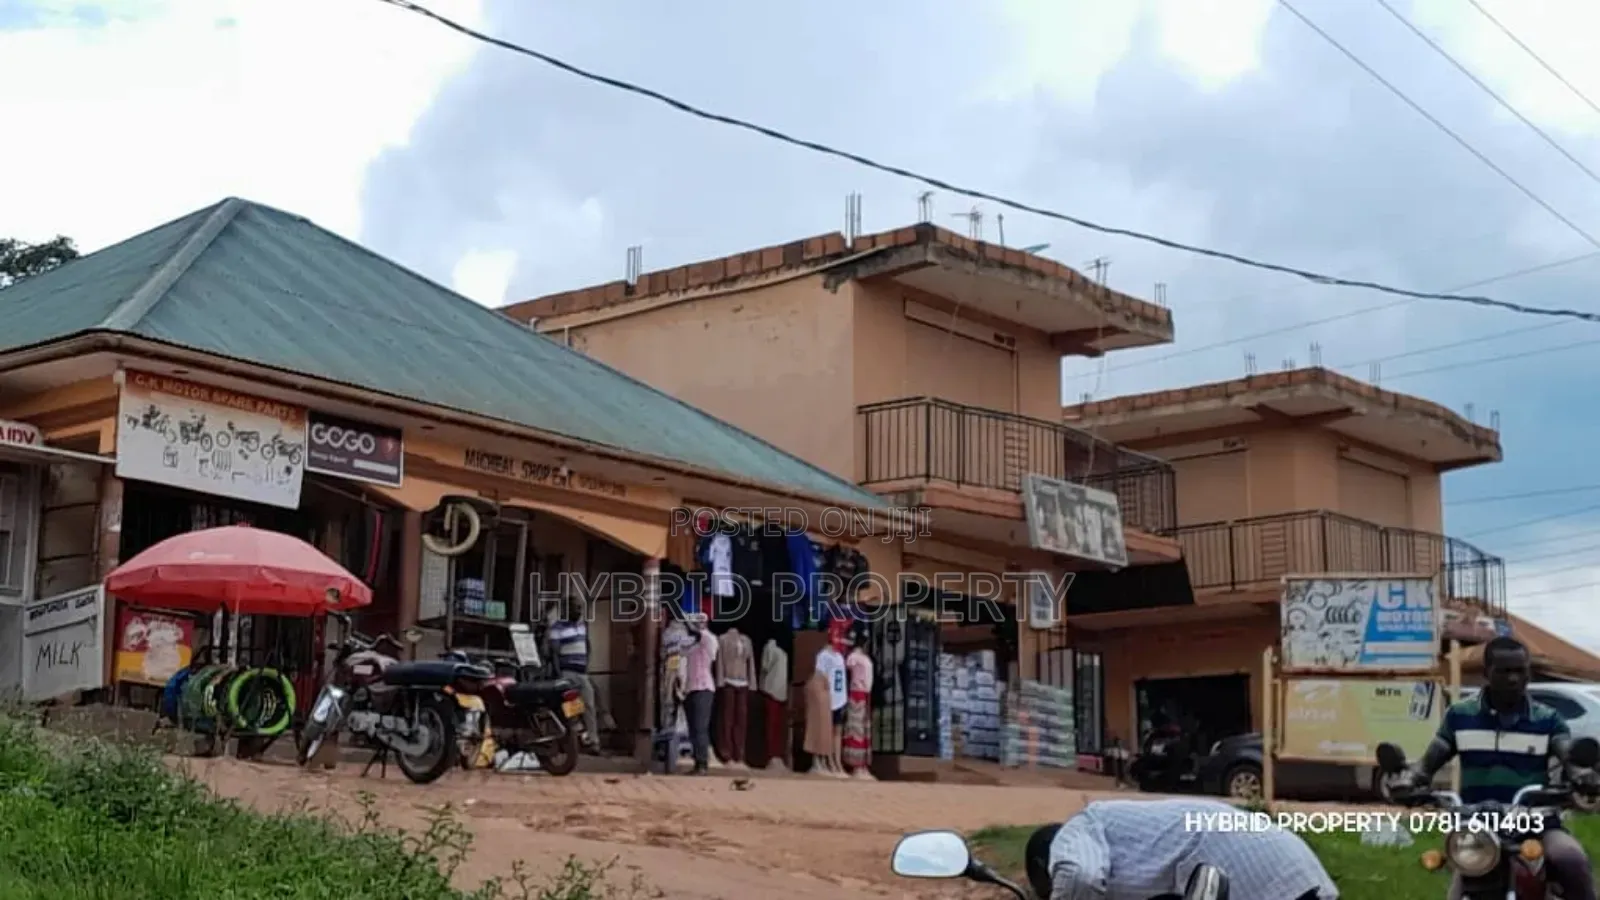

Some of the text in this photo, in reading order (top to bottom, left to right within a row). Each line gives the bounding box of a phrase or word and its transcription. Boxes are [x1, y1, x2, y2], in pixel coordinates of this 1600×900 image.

[162, 379, 210, 401] MOTOR
[256, 400, 298, 420] PARTS
[311, 422, 376, 455] GOGO
[35, 640, 83, 673] MILK
